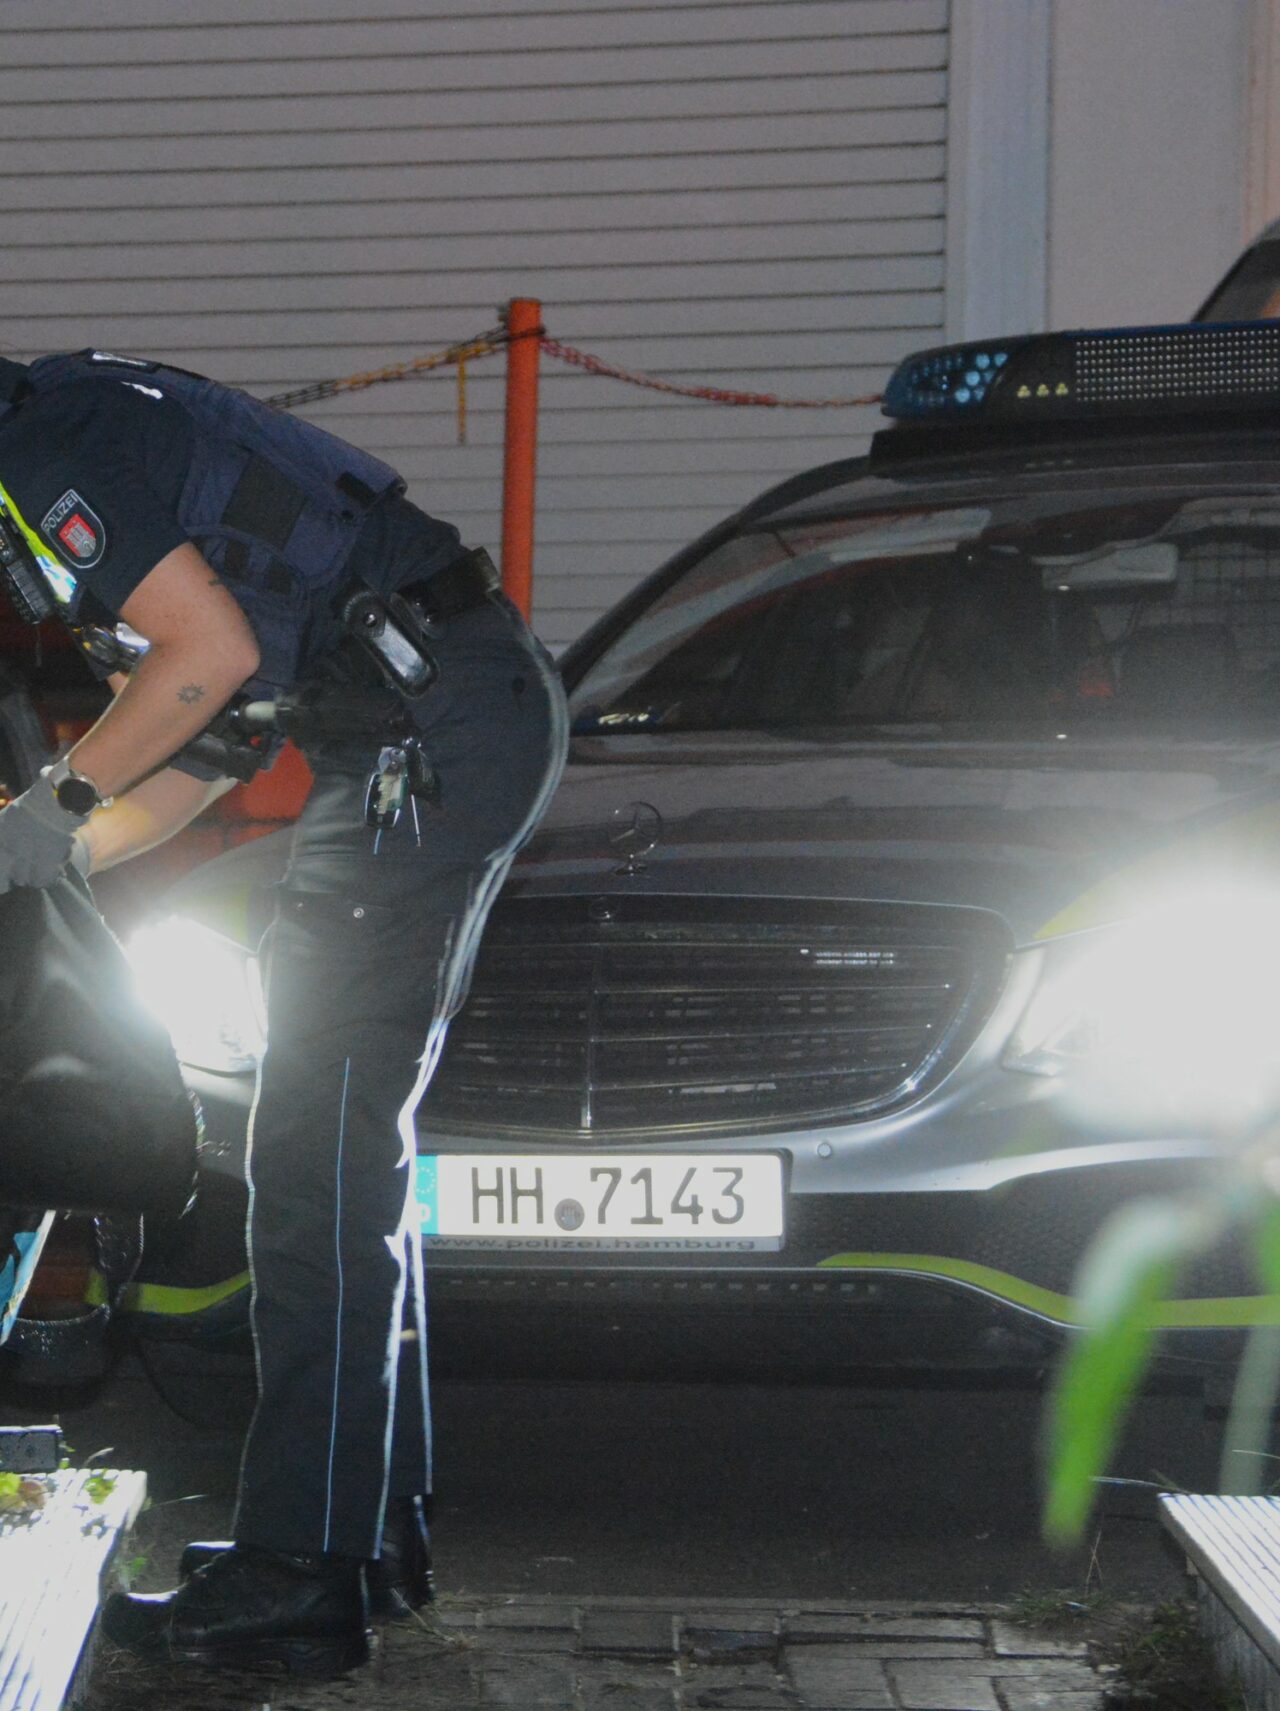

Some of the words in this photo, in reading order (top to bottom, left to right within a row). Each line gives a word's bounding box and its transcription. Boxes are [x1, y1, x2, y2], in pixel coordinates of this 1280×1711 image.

[43, 492, 79, 533] POLIZEI
[471, 1167, 544, 1224] HH
[590, 1167, 745, 1225] 7143
[428, 1236, 756, 1252] www.polizei.hamburg
